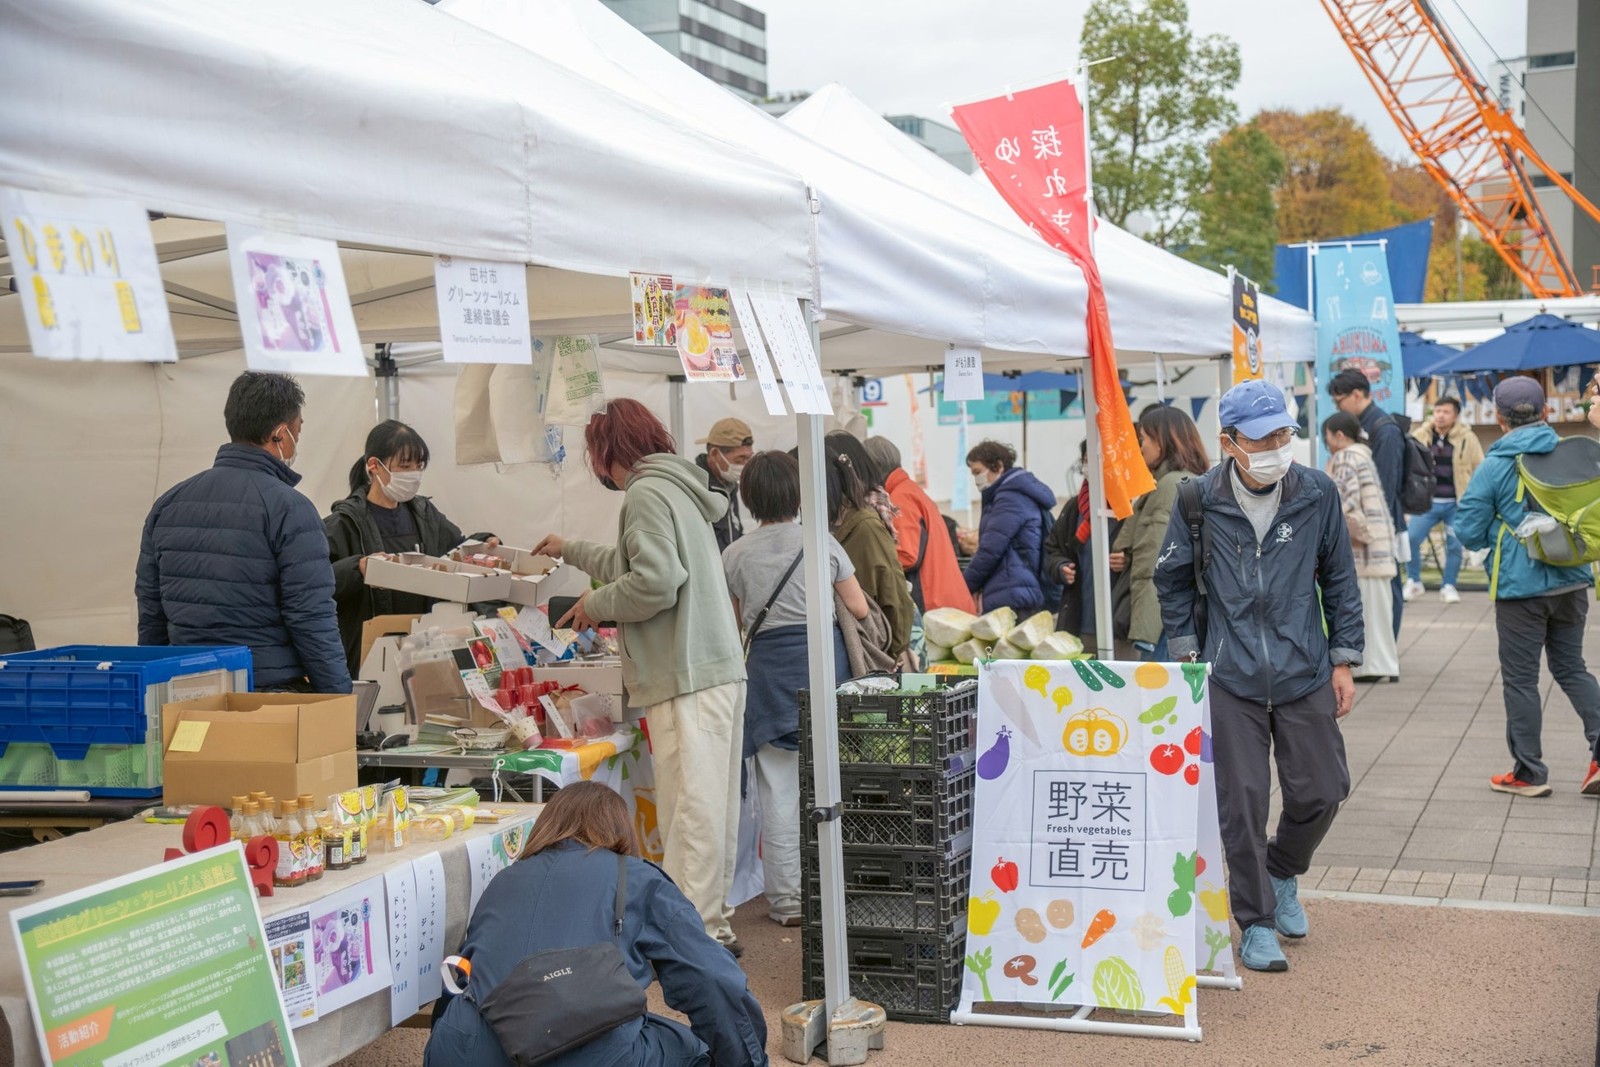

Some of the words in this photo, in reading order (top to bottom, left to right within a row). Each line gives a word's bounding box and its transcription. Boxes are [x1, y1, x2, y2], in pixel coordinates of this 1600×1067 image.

[470, 267, 497, 284] 田村市
[448, 285, 520, 305] グリーンツーリズム
[1048, 781, 1132, 822] 野菜
[1047, 824, 1074, 833] Fresh
[1077, 826, 1132, 836] vegetables
[1048, 838, 1130, 881] 直売
[544, 967, 572, 981] AIGLE
[58, 1021, 99, 1049] 活動紹介
